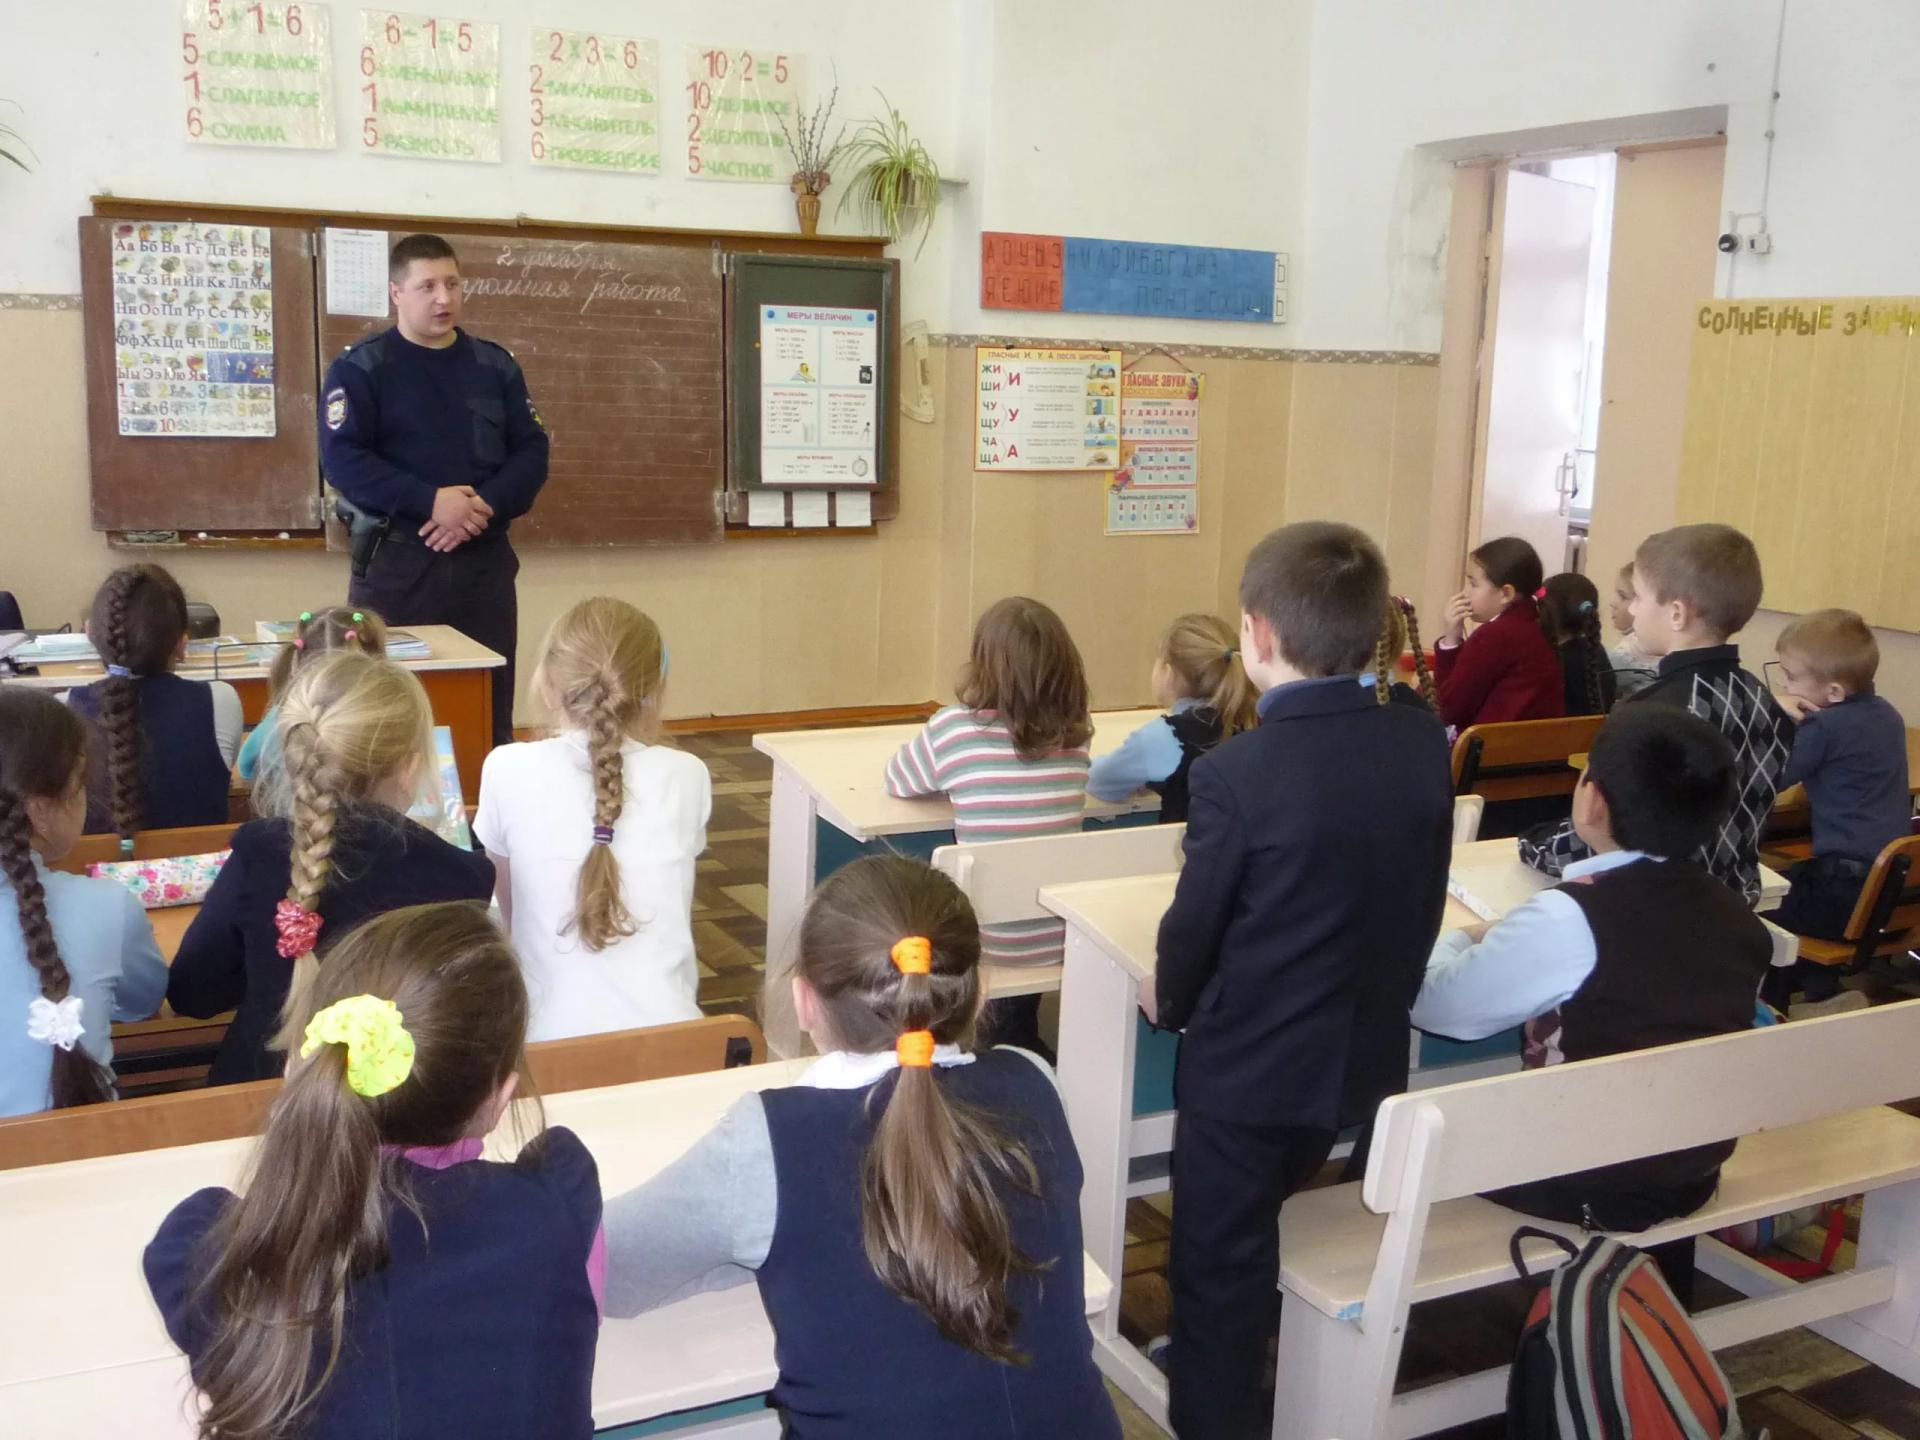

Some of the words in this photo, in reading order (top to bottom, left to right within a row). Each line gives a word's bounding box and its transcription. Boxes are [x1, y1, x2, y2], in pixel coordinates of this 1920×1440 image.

[787, 311, 812, 320] МЕРЫ
[815, 313, 852, 321] ВЕЛИЧИН
[981, 363, 1001, 374] ЖИ
[1008, 372, 1021, 386] И
[981, 381, 1001, 392] ШИ
[982, 400, 998, 411] ЧУ
[1008, 408, 1020, 422] У
[981, 418, 1000, 430] ЩУ
[982, 436, 998, 446] ЧА
[1007, 444, 1019, 458] А
[980, 453, 1000, 465] ЩА
